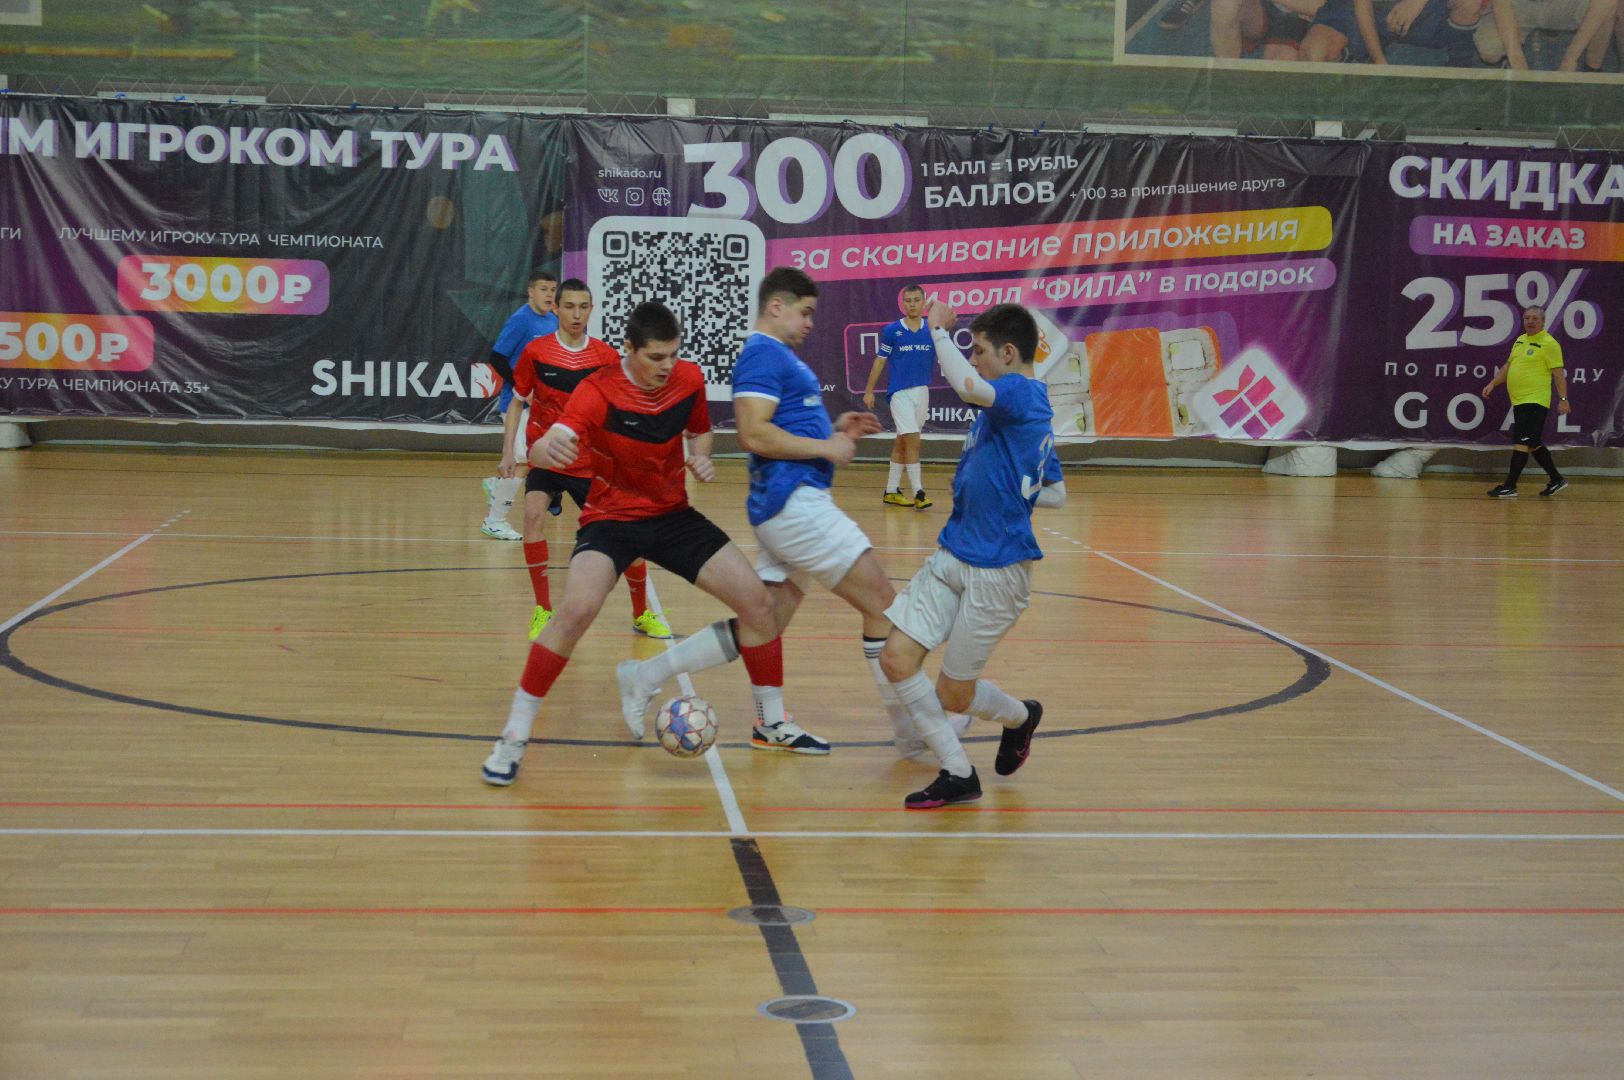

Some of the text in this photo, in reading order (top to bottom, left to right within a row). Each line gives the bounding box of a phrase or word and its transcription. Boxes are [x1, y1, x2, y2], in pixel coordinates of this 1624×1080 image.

[0, 117, 516, 171] М ИГРОКОМ ТУРА
[598, 167, 662, 179] shikado.ru
[684, 133, 909, 223] 300
[921, 163, 928, 177] 1
[934, 161, 985, 176] БАЛЛ
[1005, 158, 1013, 172] 1
[1017, 155, 1079, 172] РУБЛЬ
[924, 181, 1056, 209] БАЛЛОВ
[1111, 187, 1127, 199] за
[1131, 181, 1238, 199] приглашение
[1241, 178, 1286, 193] друга
[59, 227, 384, 249] ЛУЧШЕМУ ИГРОКУ ТУРА ЧЕМПИОНАТА
[791, 218, 1299, 270] за скачивание приложения
[1433, 223, 1585, 249] НА ЗАКАЗ
[948, 286, 1022, 308] ролл
[1159, 273, 1175, 293] в
[1184, 263, 1316, 291] подарок
[1401, 268, 1598, 350] 25%
[1385, 362, 1419, 376] ПО
[18, 378, 59, 390] ТУРА
[63, 378, 180, 393] ЧЕМПИОНАТА
[183, 381, 211, 394] 35+
